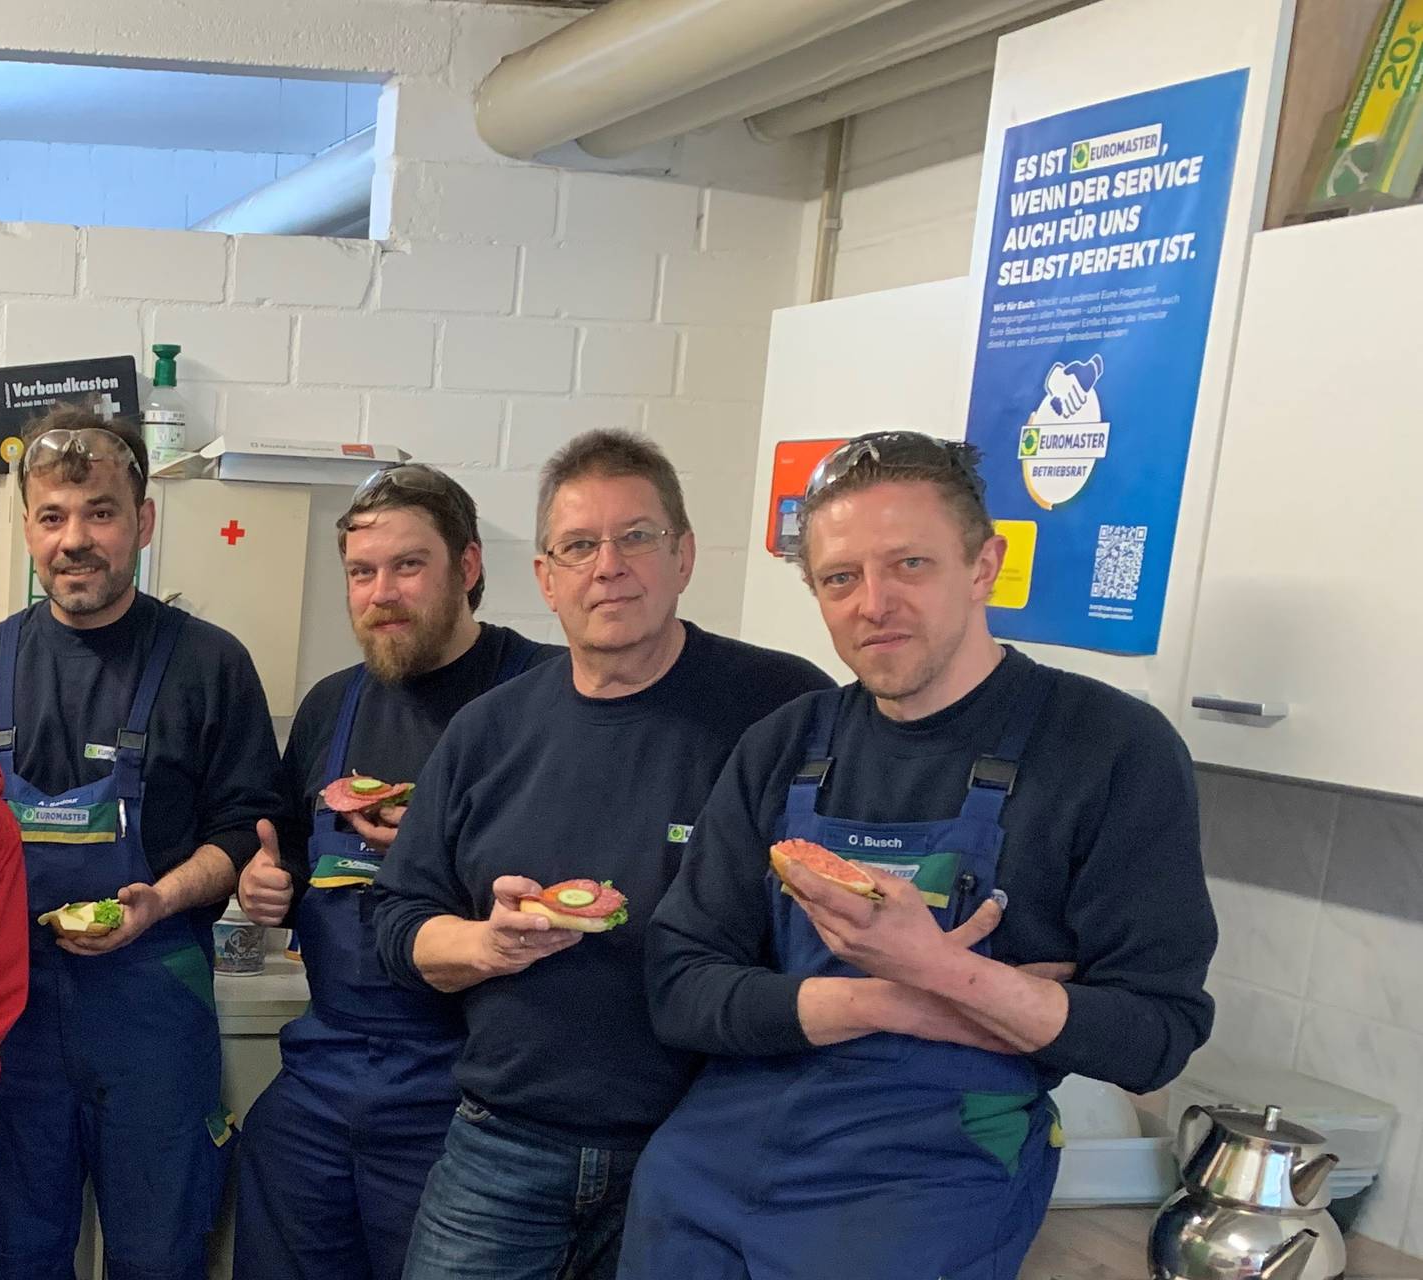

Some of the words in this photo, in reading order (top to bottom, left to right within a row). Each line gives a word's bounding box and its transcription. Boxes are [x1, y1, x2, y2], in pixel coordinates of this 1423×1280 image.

[1014, 157, 1039, 183] ES
[1040, 148, 1067, 178] IST
[1011, 182, 1067, 217] WENN
[1069, 175, 1110, 206] DER
[1112, 155, 1204, 198] SERVICE
[1002, 221, 1057, 252] AUCH
[1058, 209, 1097, 243] FÜR
[1098, 205, 1142, 237] UNS
[997, 253, 1069, 286] SELBST
[1069, 239, 1160, 277] PERFEKT
[1159, 232, 1196, 263] IST.
[12, 376, 119, 398] Verbandkasten
[1039, 432, 1106, 450] EUROMASTER
[1032, 466, 1088, 477] BETRIEBSRAT
[35, 811, 87, 821] EUROMASTER
